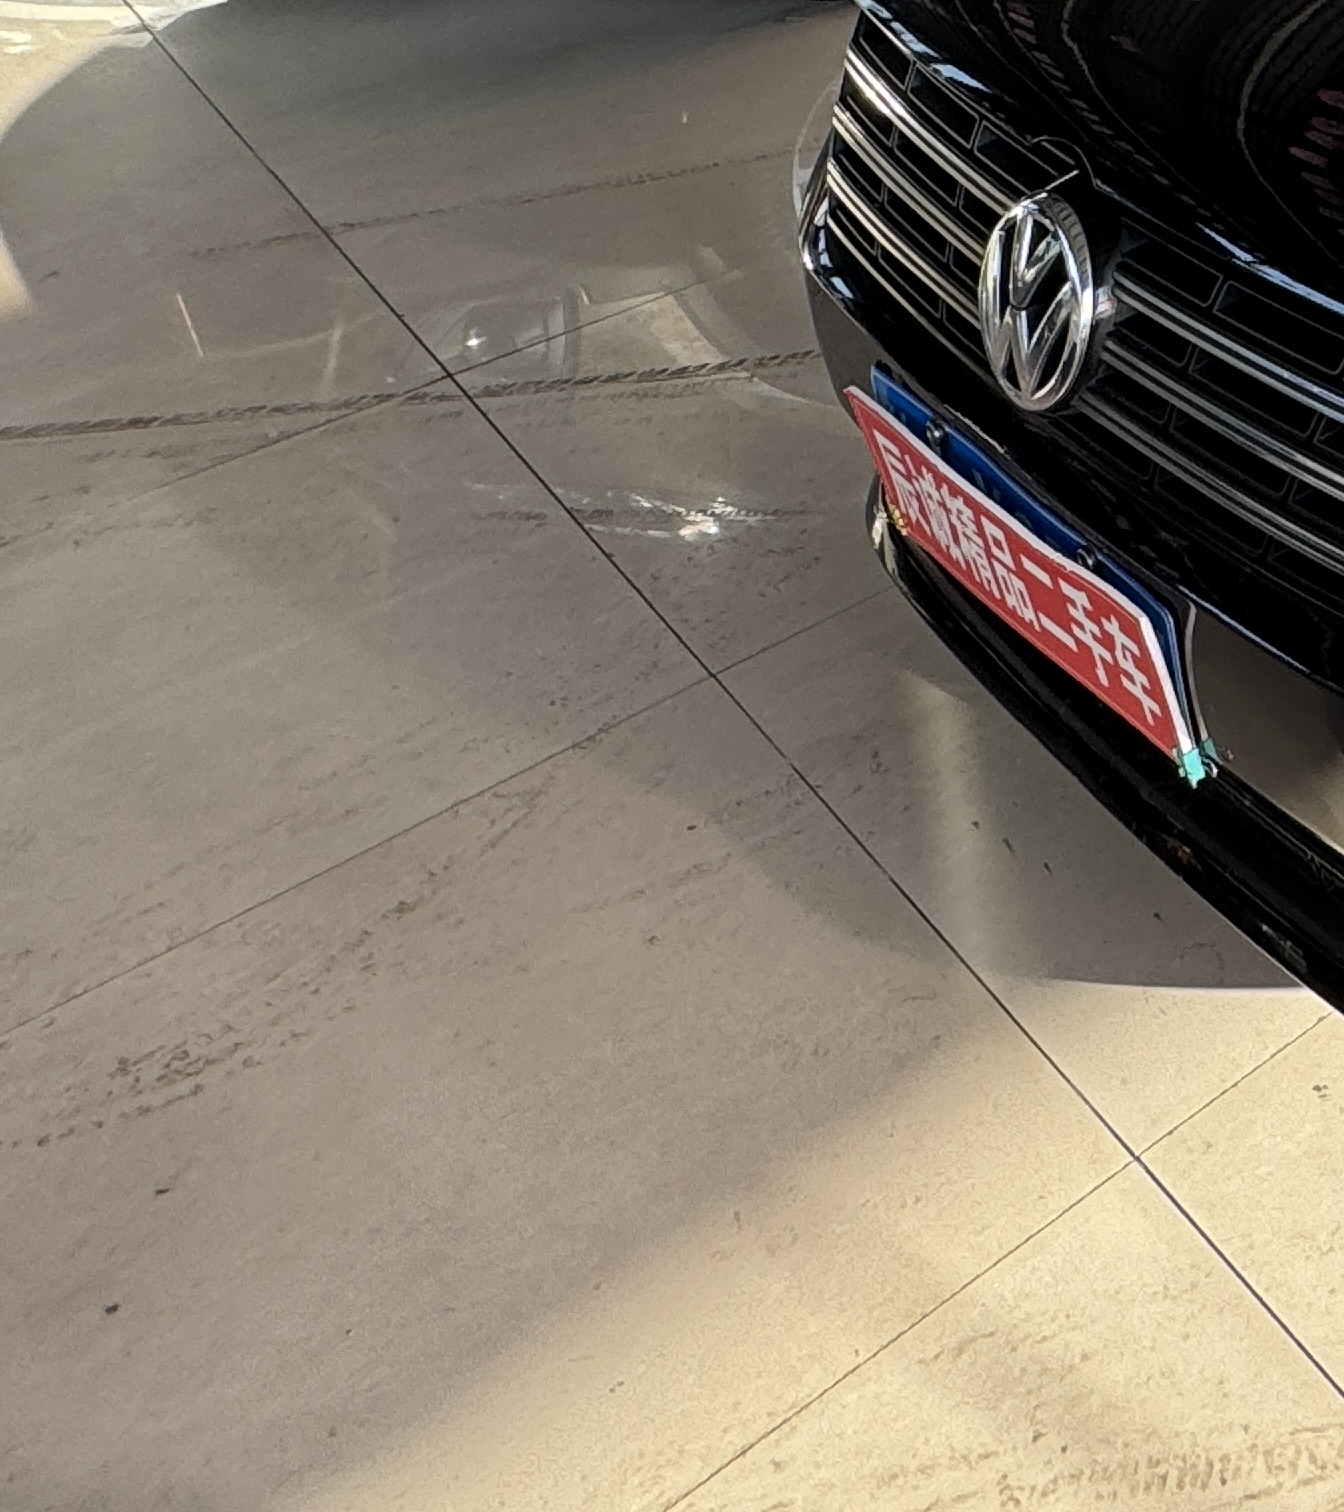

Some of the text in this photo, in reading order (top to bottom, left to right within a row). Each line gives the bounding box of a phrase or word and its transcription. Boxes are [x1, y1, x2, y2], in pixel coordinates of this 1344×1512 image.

[872, 427, 1160, 727] 辰诚精品二手车
